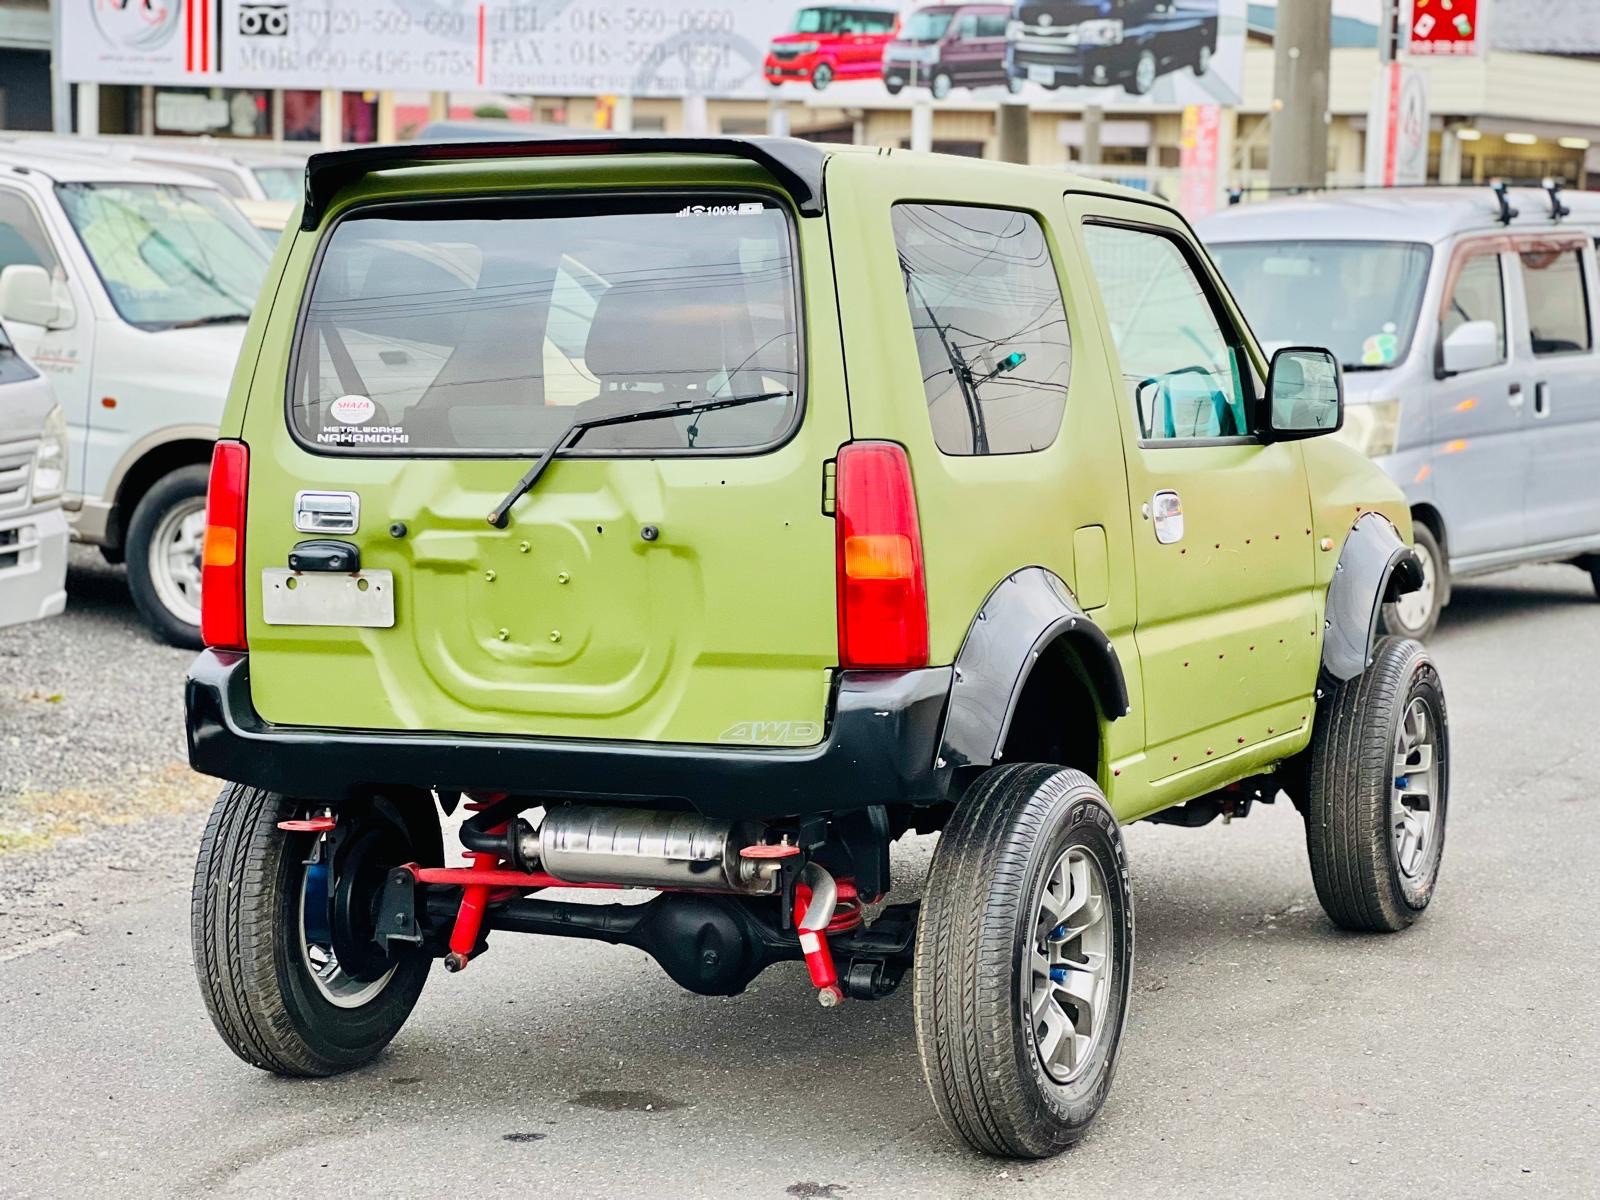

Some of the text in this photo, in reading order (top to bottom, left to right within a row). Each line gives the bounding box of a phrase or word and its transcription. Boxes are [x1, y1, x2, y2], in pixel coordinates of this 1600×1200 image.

[706, 206, 738, 216] 100%
[323, 426, 403, 434] METALWORKS
[317, 434, 409, 443] NAKAMICHI
